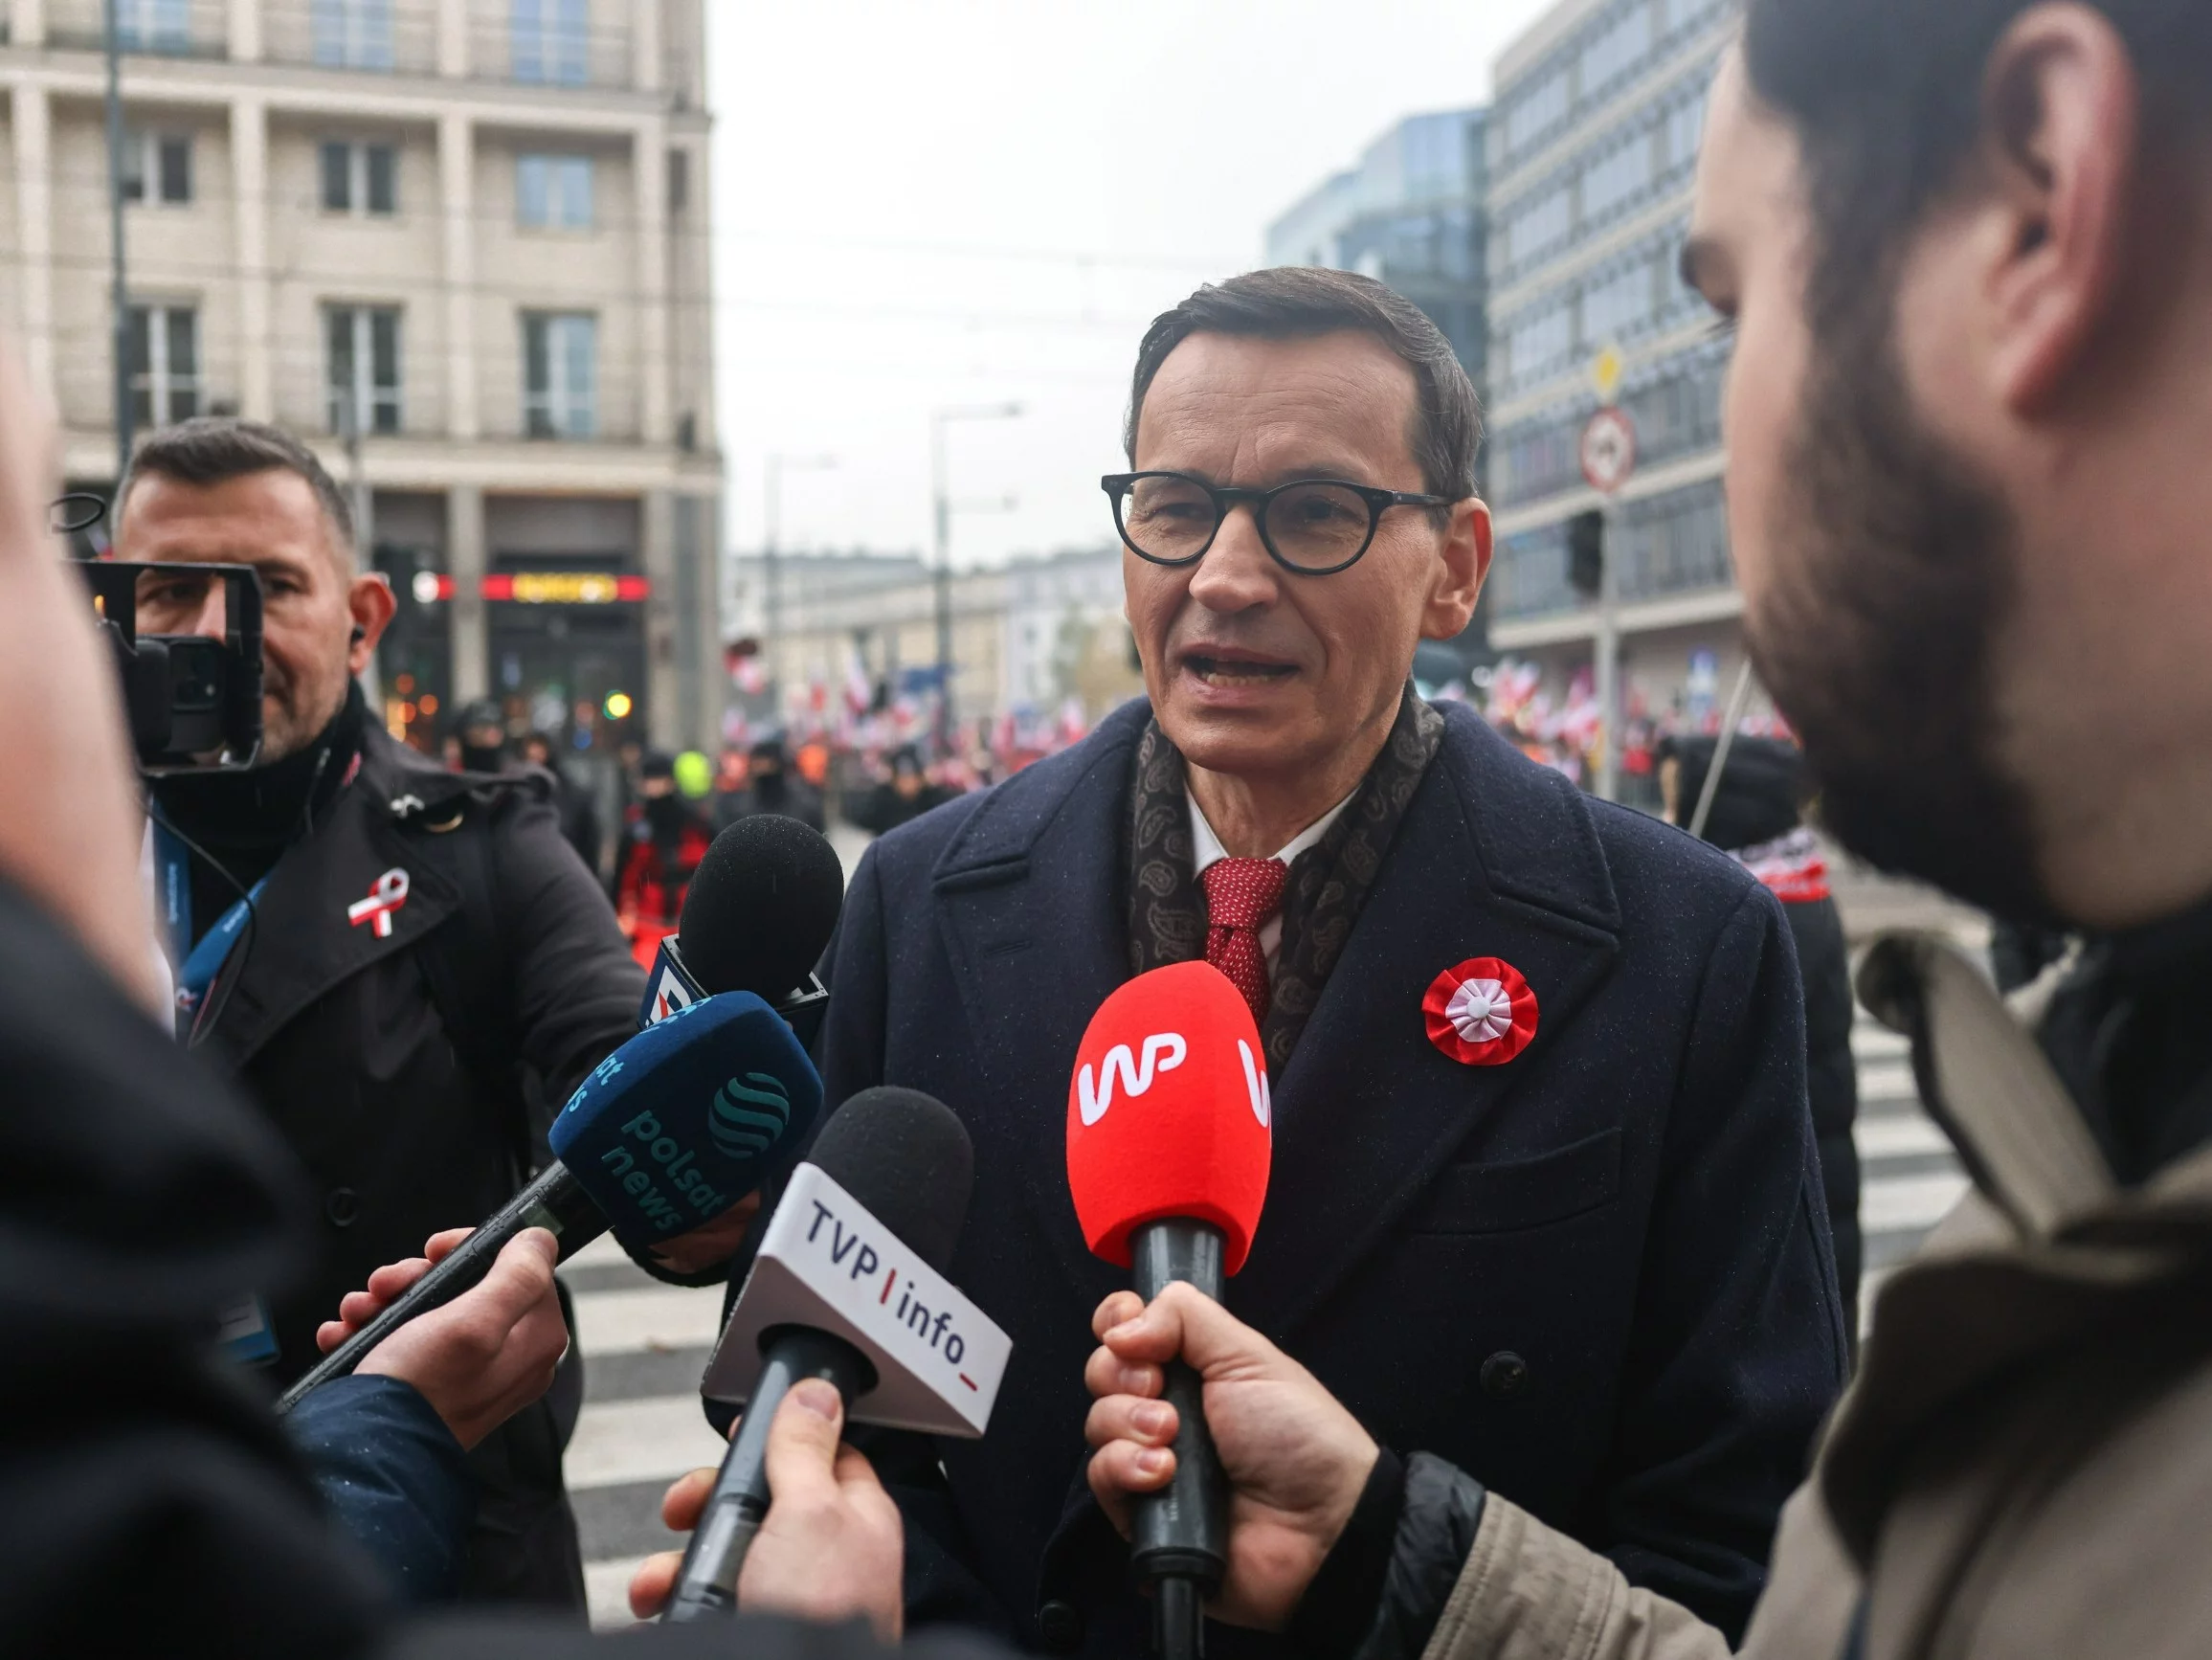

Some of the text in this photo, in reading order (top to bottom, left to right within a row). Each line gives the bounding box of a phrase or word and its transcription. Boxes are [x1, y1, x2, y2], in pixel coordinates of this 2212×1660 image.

[1078, 1032, 1187, 1127] WP
[600, 1145, 683, 1231] news
[620, 1110, 726, 1216] polsat
[807, 1199, 879, 1280] TVP
